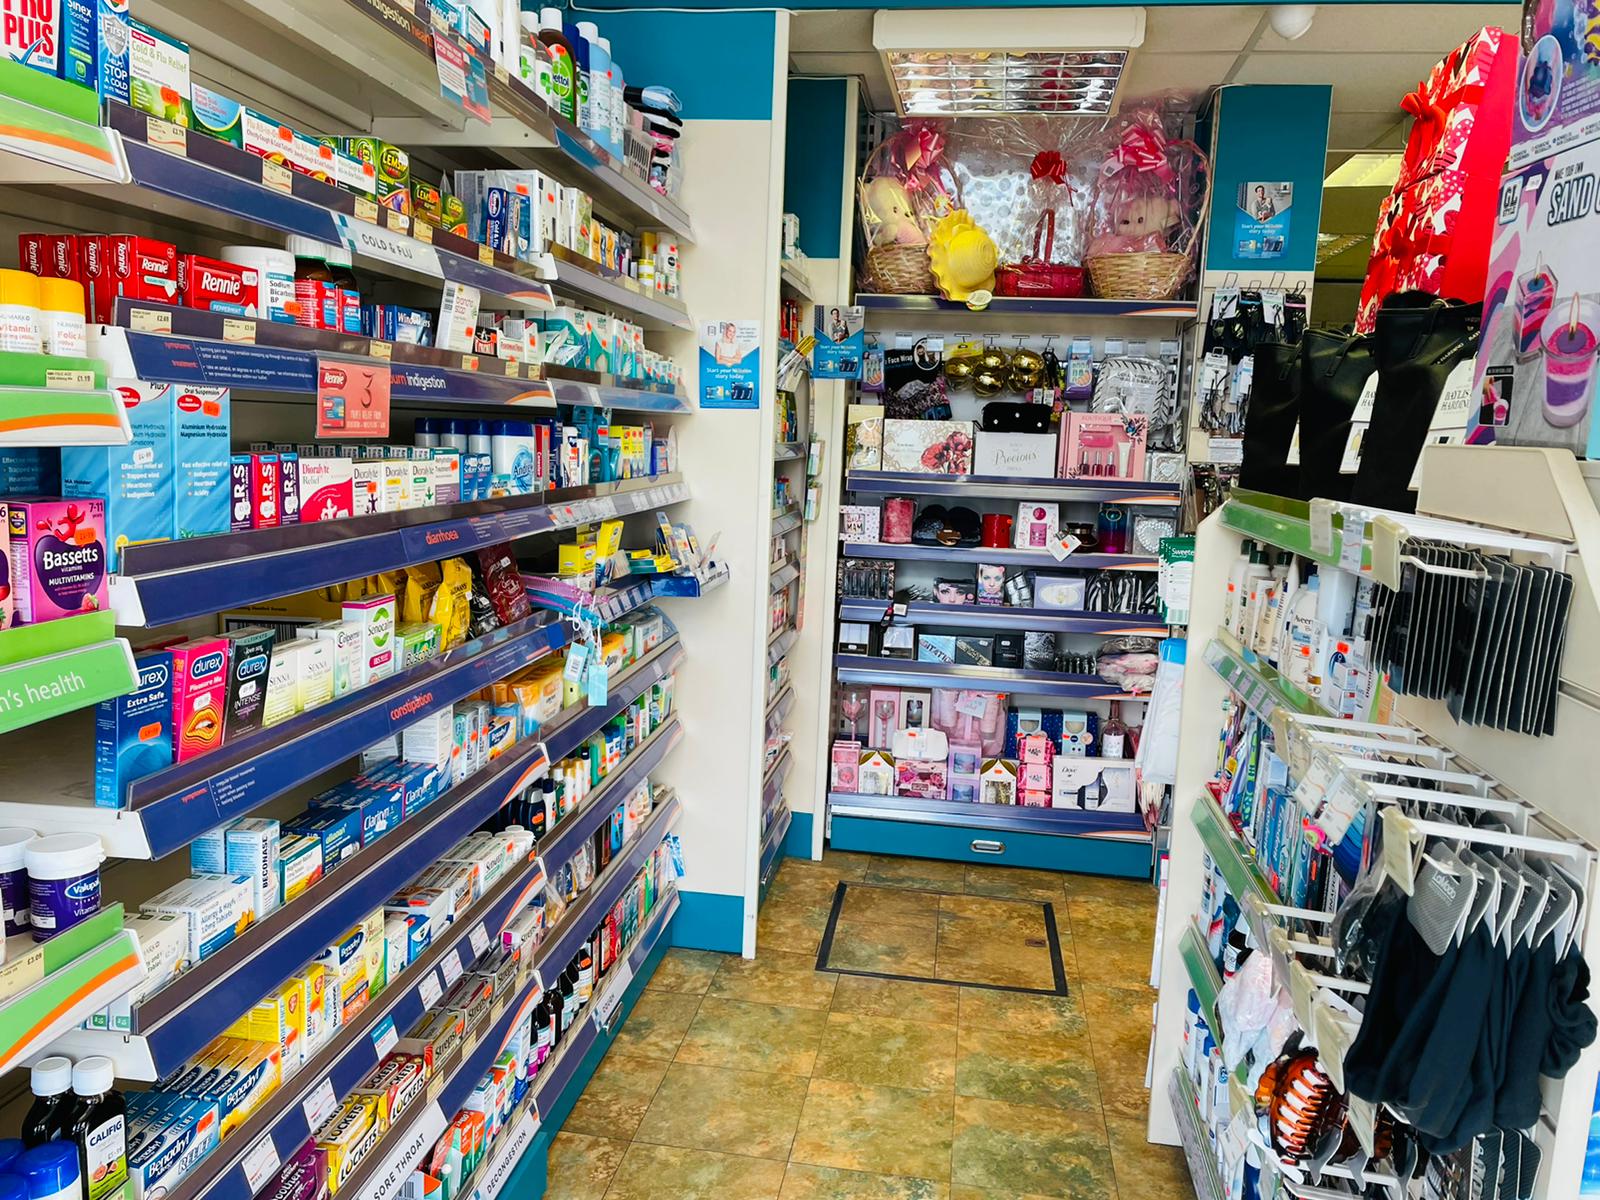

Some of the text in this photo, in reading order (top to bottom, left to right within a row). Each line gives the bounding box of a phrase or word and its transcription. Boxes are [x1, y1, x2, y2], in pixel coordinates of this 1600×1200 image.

[3, 0, 53, 22] PRO
[3, 12, 54, 57] PLUS
[104, 20, 127, 38] First
[132, 40, 149, 54] Cold
[103, 63, 128, 81] STOP
[552, 73, 569, 87] ettol
[111, 77, 128, 91] COLD
[1503, 184, 1518, 209] GL
[1547, 172, 1596, 227] SAND
[361, 232, 413, 259] COLD & FLU
[29, 240, 39, 273] Rennie
[57, 241, 68, 273] Rennie
[88, 241, 99, 275] Rennie
[118, 242, 128, 275] Rennie
[142, 258, 169, 274] Rennie
[201, 271, 241, 296] Rennie
[269, 280, 291, 290] Sodium
[887, 354, 913, 364] Face Wrap
[323, 372, 345, 386] Rennie
[706, 366, 719, 374] Start
[719, 367, 732, 375] your
[406, 372, 447, 391] indigestion
[1440, 400, 1470, 410] HARDIN
[180, 432, 207, 440] Magnesium
[993, 449, 1038, 466] Precious
[354, 467, 379, 480] Dioralyte
[385, 465, 409, 477] Dioralyte
[413, 464, 434, 476] Dioralyte
[425, 529, 460, 545] diarrhoea
[43, 547, 99, 571] Bassetts
[48, 572, 95, 587] MULTIVITAMINS
[194, 655, 222, 675] durex
[239, 659, 265, 676] durex
[24, 671, 86, 704] health
[138, 670, 165, 688] urex
[190, 676, 223, 692] Pleasure Me
[127, 691, 165, 708] Extra Safe
[234, 691, 262, 710] INTENSE
[390, 691, 433, 721] constipation
[1061, 766, 1077, 774] Dove
[262, 835, 270, 890] BECONASE
[366, 1062, 397, 1089] OCKETS
[226, 1066, 261, 1107] Benadryl
[391, 1075, 425, 1120] LOCKETS
[314, 1103, 344, 1136] OCKETS
[327, 1103, 364, 1142] LOCKETS
[89, 1121, 122, 1147] CALIFIG
[148, 1130, 192, 1178] Benadryl
[340, 1126, 378, 1182] LOCKETS
[486, 1130, 527, 1194] DECONGESTION
[373, 1133, 426, 1200] SORE THROAT
